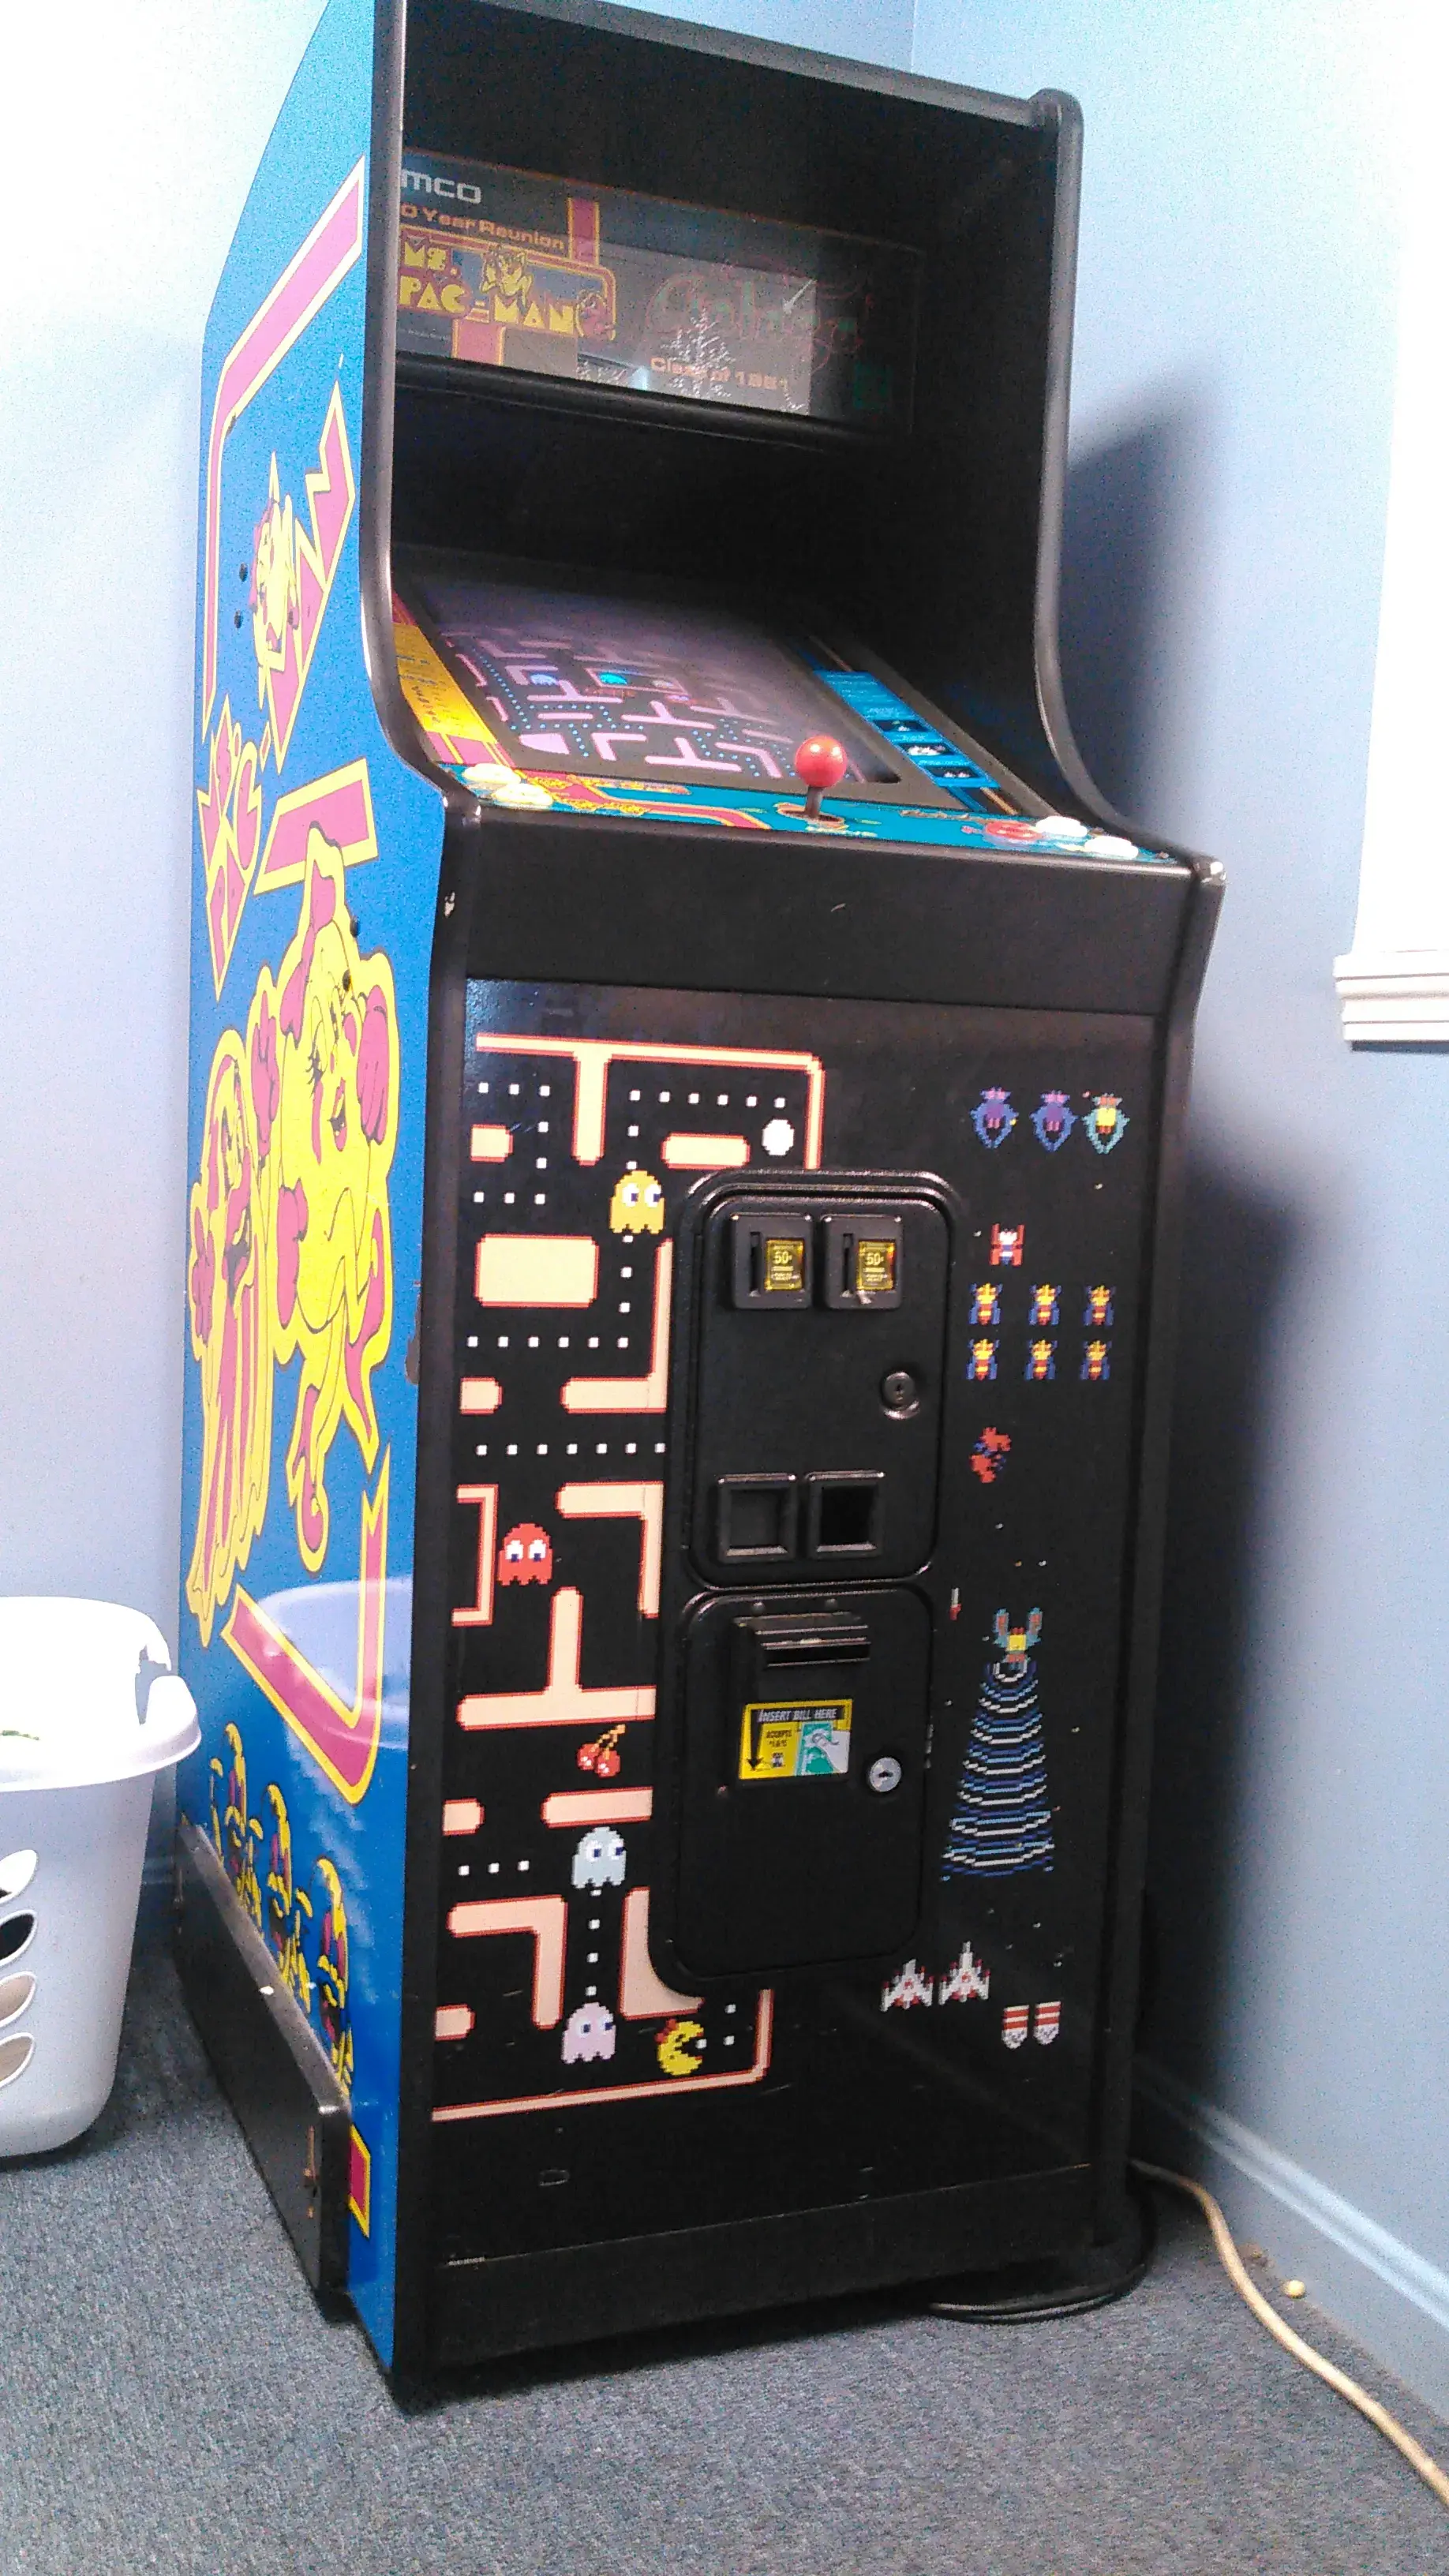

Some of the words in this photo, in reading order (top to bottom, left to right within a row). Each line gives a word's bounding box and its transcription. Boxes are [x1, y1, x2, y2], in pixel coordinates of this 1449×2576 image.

[401, 168, 482, 205] mco
[400, 202, 417, 219] 0
[478, 219, 565, 251] Reunion
[758, 1709, 791, 1723] INSERT
[792, 1709, 811, 1720] BILL
[814, 1708, 837, 1720] HERE
